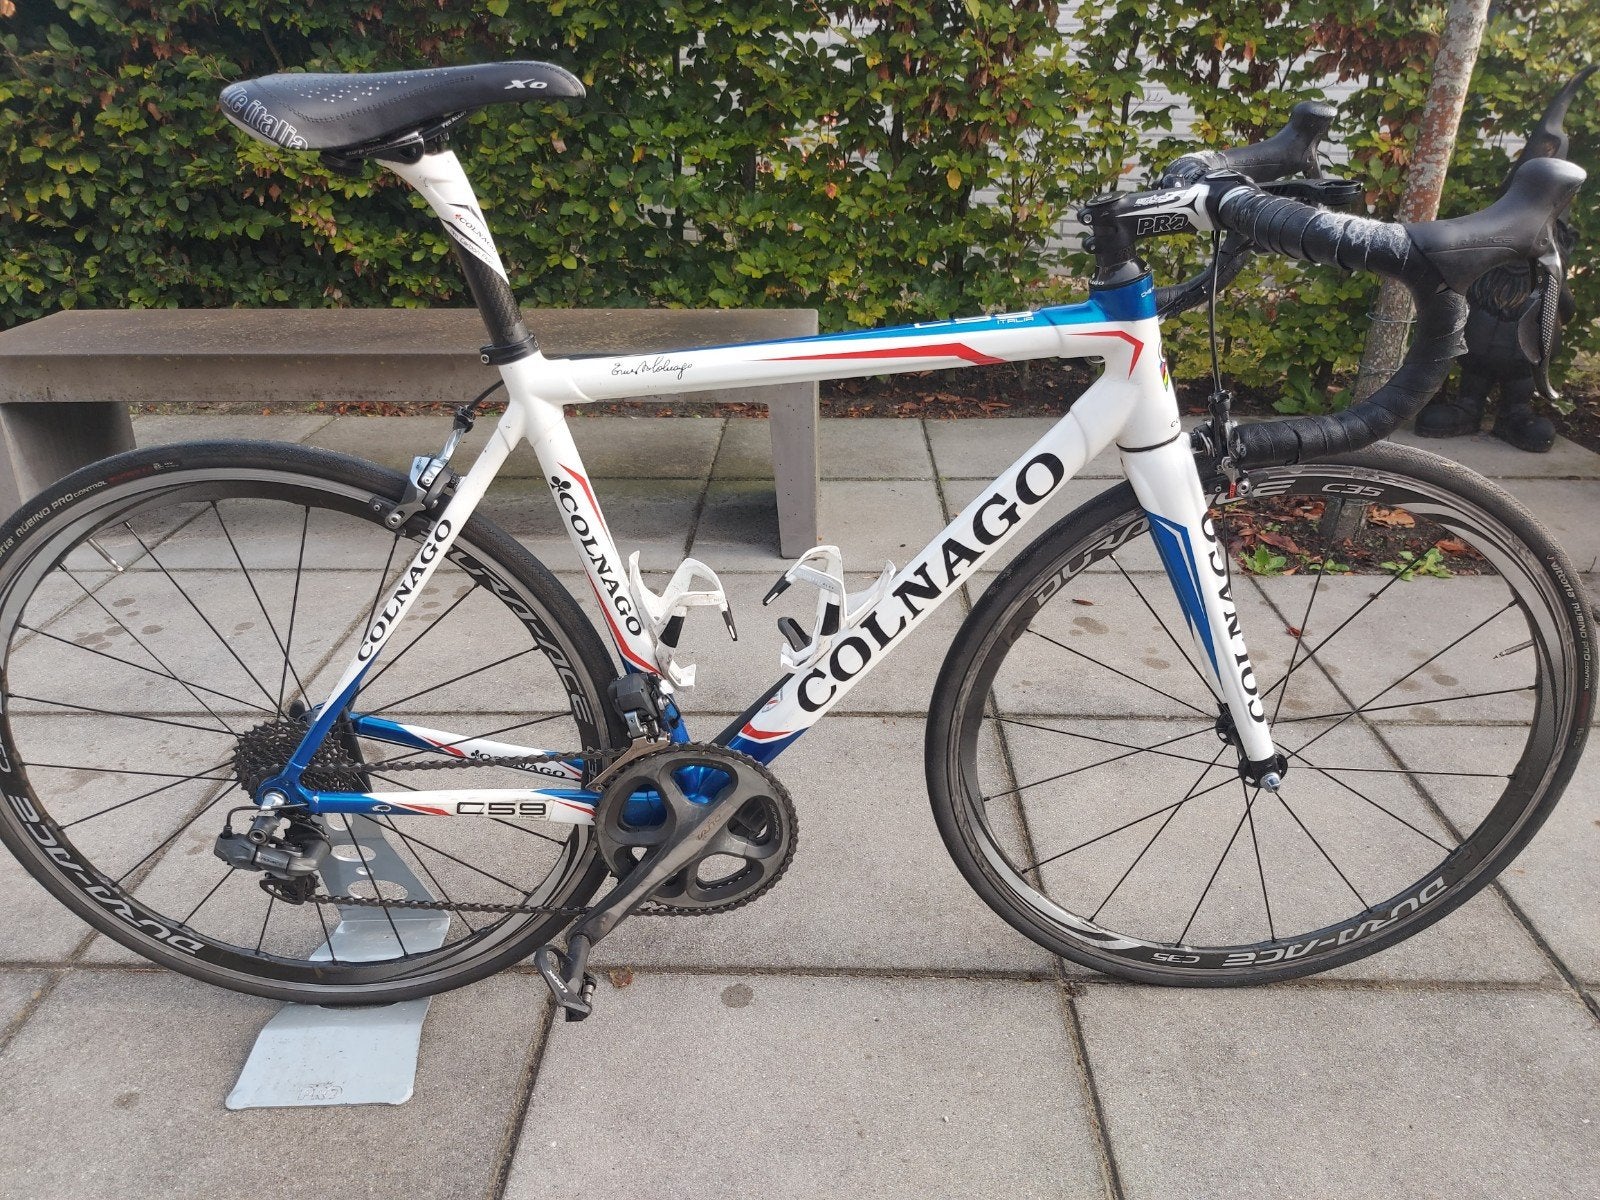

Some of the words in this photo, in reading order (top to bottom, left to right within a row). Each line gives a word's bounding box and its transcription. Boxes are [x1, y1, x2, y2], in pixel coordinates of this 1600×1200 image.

[1136, 213, 1189, 236] PRO
[997, 317, 1035, 325] ITALIA
[15, 508, 51, 538] RUBINO
[52, 493, 74, 511] PRO
[73, 480, 108, 499] CONTROL
[1321, 483, 1385, 497] C35
[356, 519, 452, 662] COLNAGO
[559, 492, 642, 637] COLNAGO
[797, 452, 1065, 713] COLNAGO
[447, 546, 594, 726] URA-ACE
[1550, 561, 1576, 599] vittoria
[1571, 601, 1588, 639] RUBINO
[1581, 640, 1591, 661] PRO
[479, 753, 566, 778] CNAGO
[456, 801, 547, 816] C59
[8, 795, 205, 955] DURA-ACE
[1221, 875, 1448, 967] DURA-ACE
[546, 969, 568, 993] LOOK
[1152, 951, 1200, 964] C35
